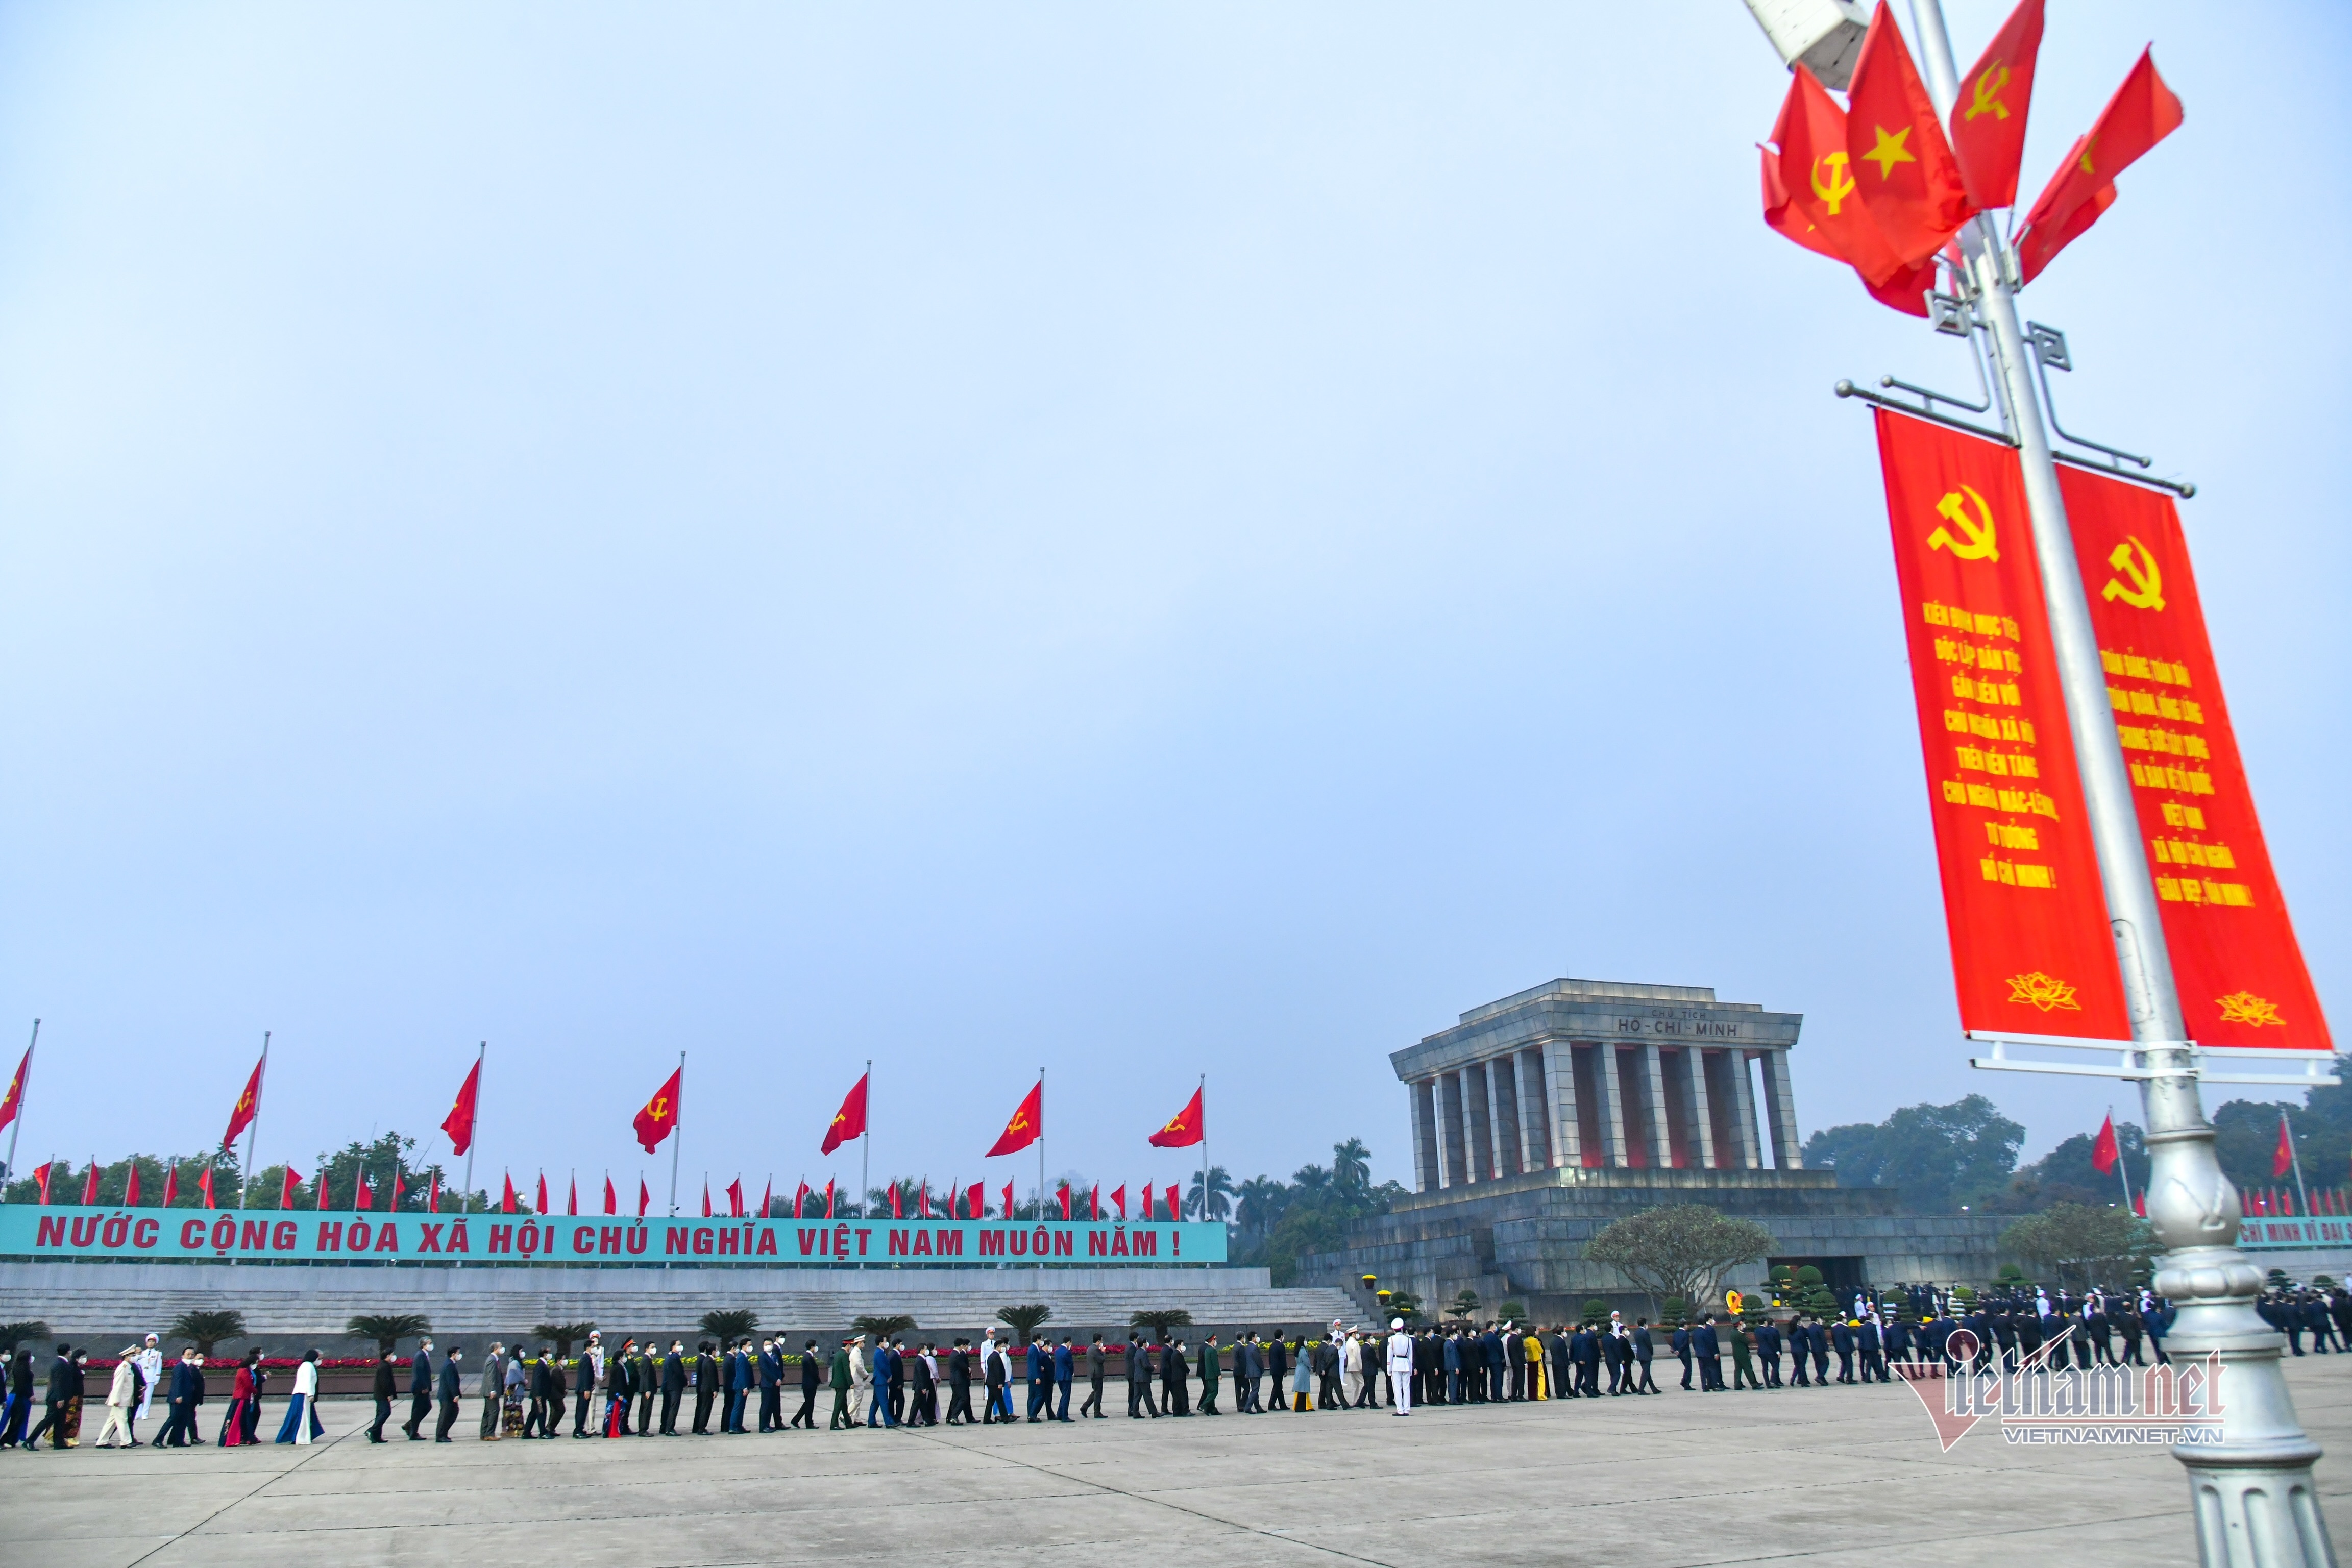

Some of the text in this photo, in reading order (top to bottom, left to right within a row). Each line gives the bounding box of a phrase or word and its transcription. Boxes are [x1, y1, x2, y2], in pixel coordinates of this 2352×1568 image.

[36, 1212, 159, 1248] NƯỚC
[180, 1214, 298, 1255] CỘNG
[317, 1213, 399, 1252] HÒA
[418, 1218, 469, 1252] XÃ
[488, 1219, 555, 1259] HỘI
[573, 1218, 648, 1254] CHỦ
[666, 1222, 777, 1255] NGHĨA
[798, 1223, 872, 1260] VIỆT
[889, 1230, 963, 1256] NAM
[979, 1225, 1073, 1256] MUÔN
[1089, 1225, 1157, 1256] NĂM
